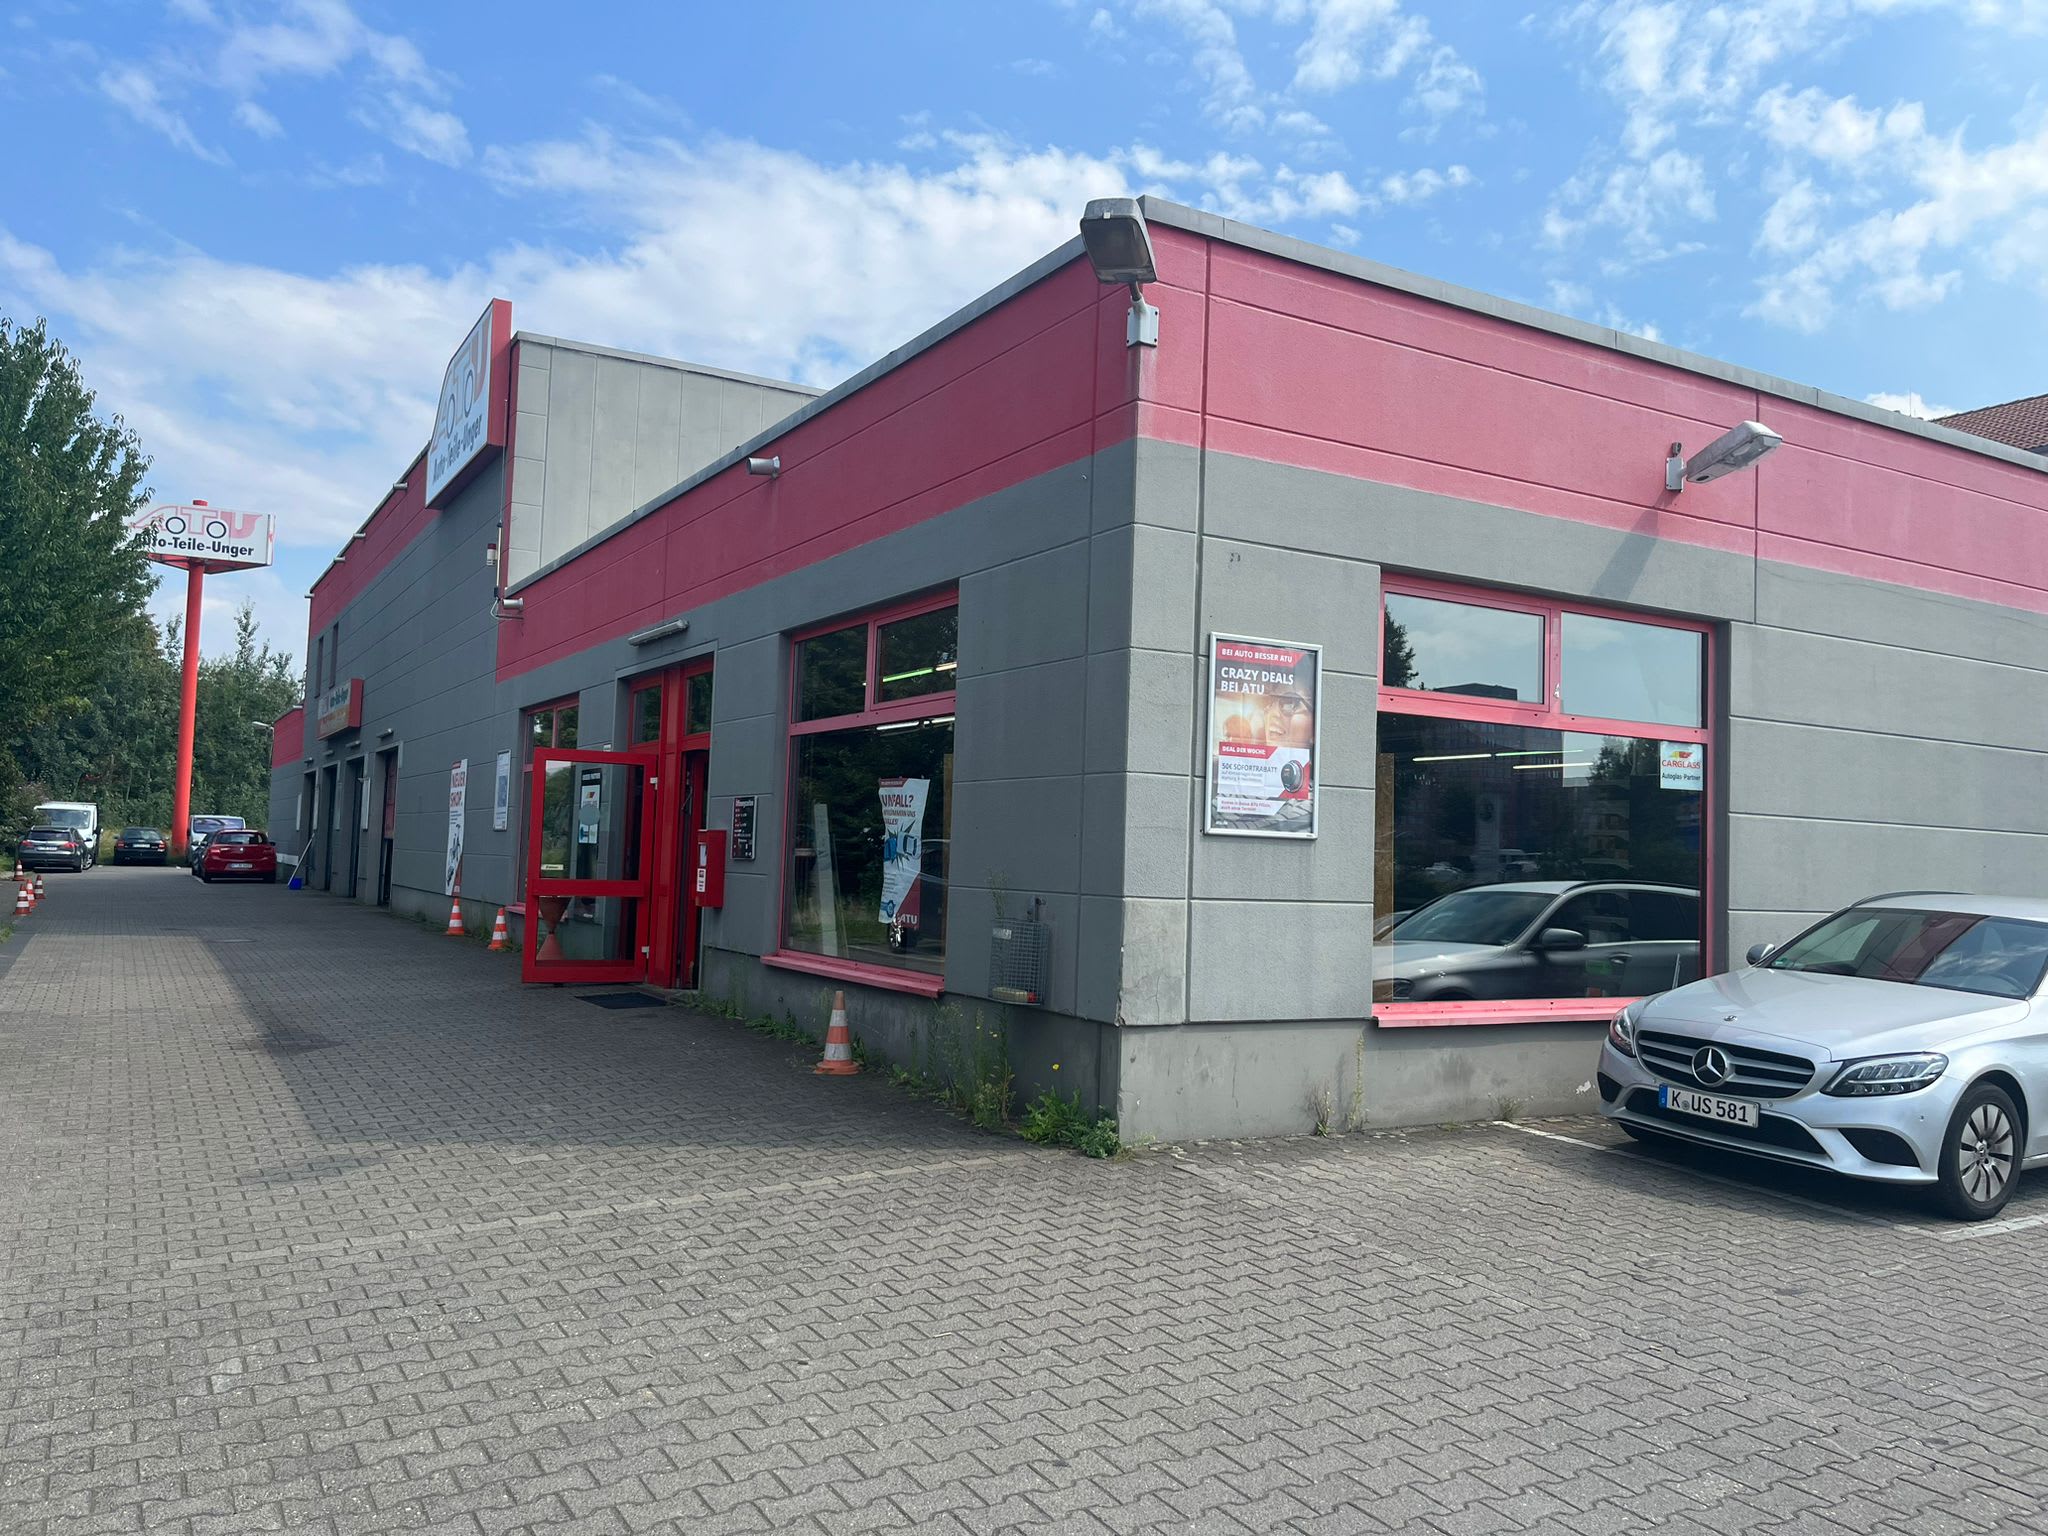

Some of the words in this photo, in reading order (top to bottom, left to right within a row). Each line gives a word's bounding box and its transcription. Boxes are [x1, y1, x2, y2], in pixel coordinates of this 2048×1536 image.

[1221, 648, 1233, 656] BEI
[1234, 650, 1253, 659] AUTO
[1254, 652, 1279, 662] BESSER
[1279, 655, 1293, 663] ATU
[1221, 667, 1260, 681] CRAZY
[1261, 671, 1294, 685] DEALS
[1221, 681, 1239, 693] BEI
[1241, 683, 1265, 695] ATU
[1233, 763, 1278, 773] SOFORTRABATT
[1661, 760, 1701, 770] CARGLASS
[901, 913, 918, 925] ATU
[1671, 1090, 1681, 1108] K
[1691, 1094, 1712, 1114] US
[1716, 1101, 1748, 1123] 581
